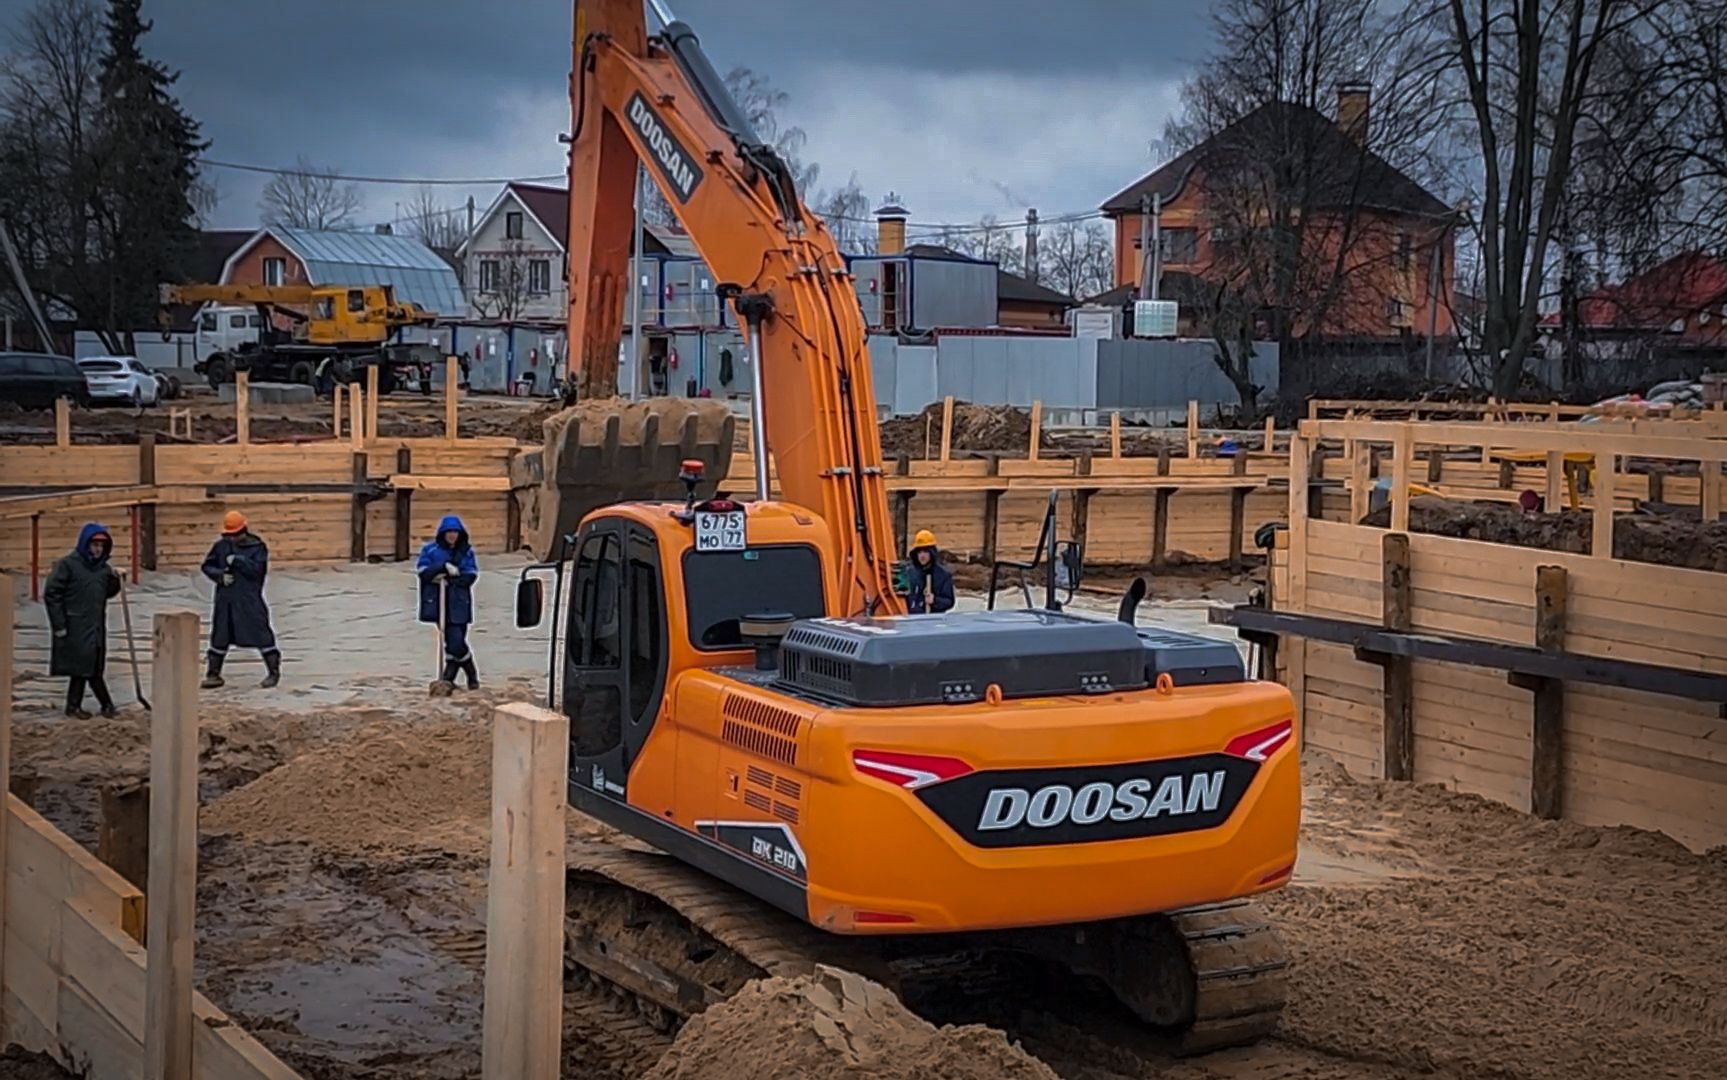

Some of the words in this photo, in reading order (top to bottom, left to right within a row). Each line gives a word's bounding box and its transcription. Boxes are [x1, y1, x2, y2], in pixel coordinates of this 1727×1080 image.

[629, 96, 695, 196] DOOSAN
[701, 514, 739, 530] 6775
[726, 532, 742, 544] 77
[977, 770, 1226, 831] DOOSAN
[773, 846, 797, 870] 210
